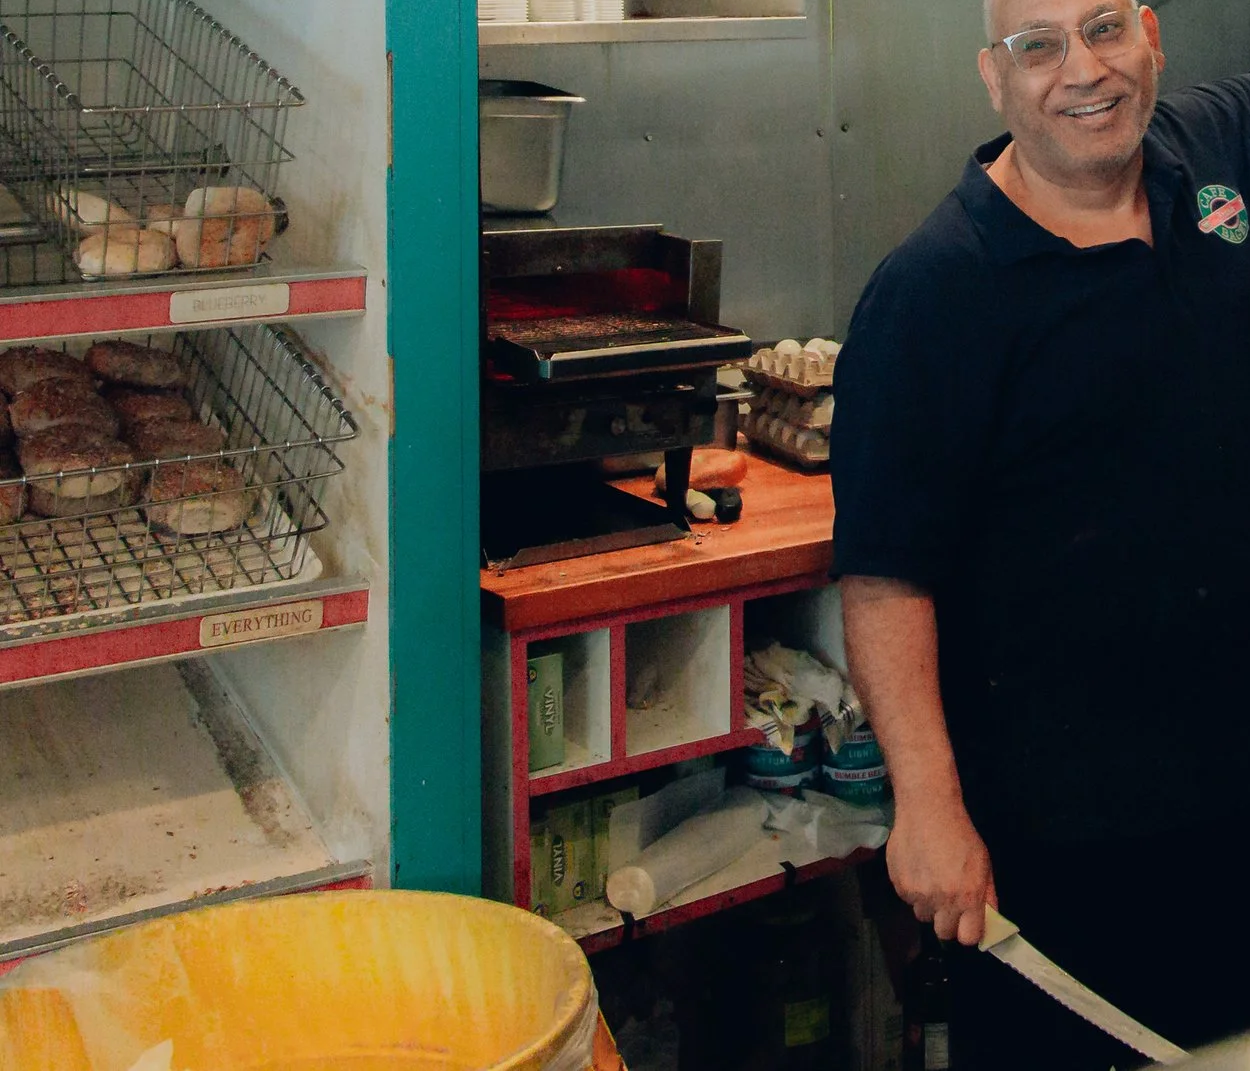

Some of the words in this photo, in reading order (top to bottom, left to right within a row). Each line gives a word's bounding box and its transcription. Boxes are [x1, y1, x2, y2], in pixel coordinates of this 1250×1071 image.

[211, 608, 312, 637] EVERYTHING
[544, 688, 556, 735] VINYL
[552, 841, 563, 883] VINYL
